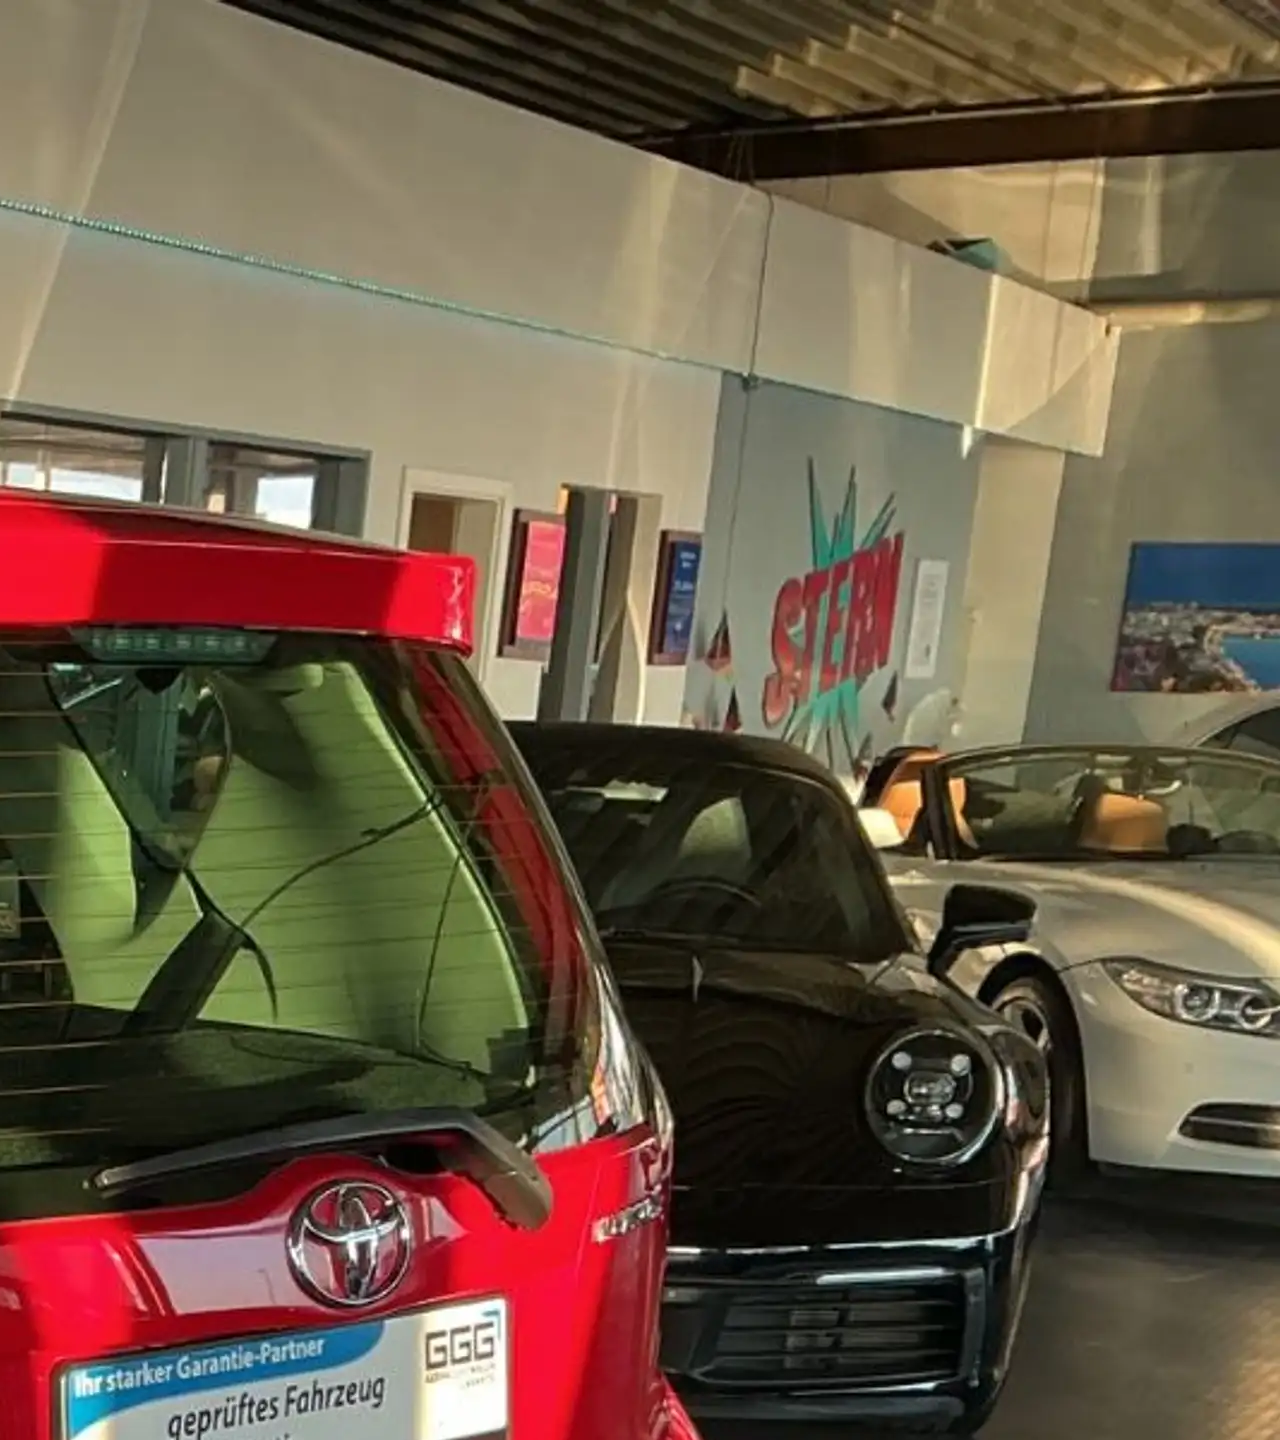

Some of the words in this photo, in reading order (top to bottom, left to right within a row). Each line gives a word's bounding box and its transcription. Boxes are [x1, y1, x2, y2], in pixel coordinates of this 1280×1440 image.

[761, 531, 905, 730] STERN
[74, 1371, 102, 1398] Ihr
[106, 1361, 172, 1393] starker
[176, 1337, 324, 1380] Garantie-Partner
[425, 1321, 494, 1371] GGG
[284, 1376, 386, 1419] Fahrzeug
